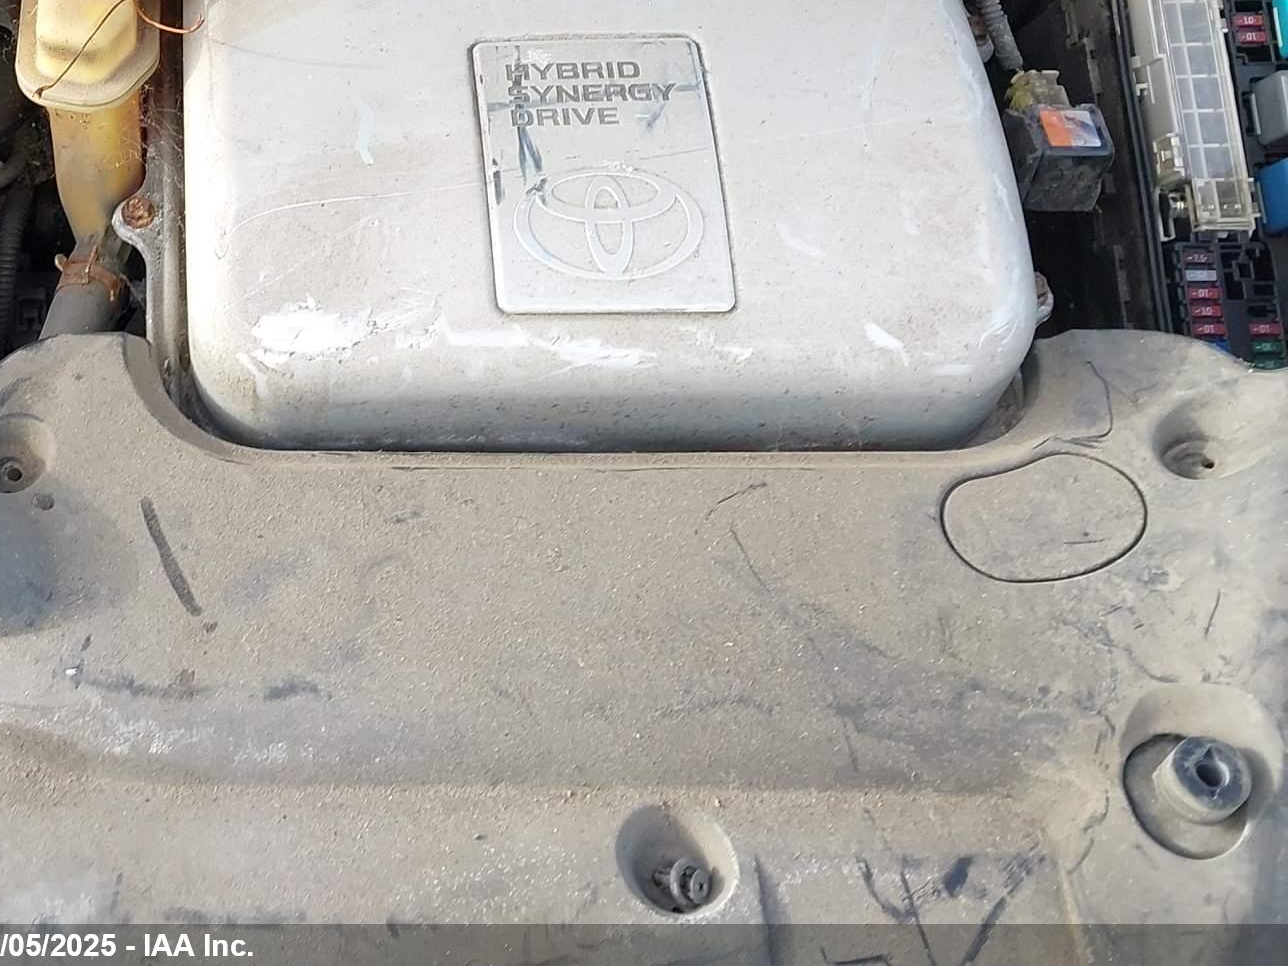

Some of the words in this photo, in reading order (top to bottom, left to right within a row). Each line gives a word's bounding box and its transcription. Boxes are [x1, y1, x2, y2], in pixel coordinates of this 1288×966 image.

[505, 61, 641, 81] HYBRID
[508, 82, 677, 104] SYNERGY
[511, 107, 620, 127] DRIVE
